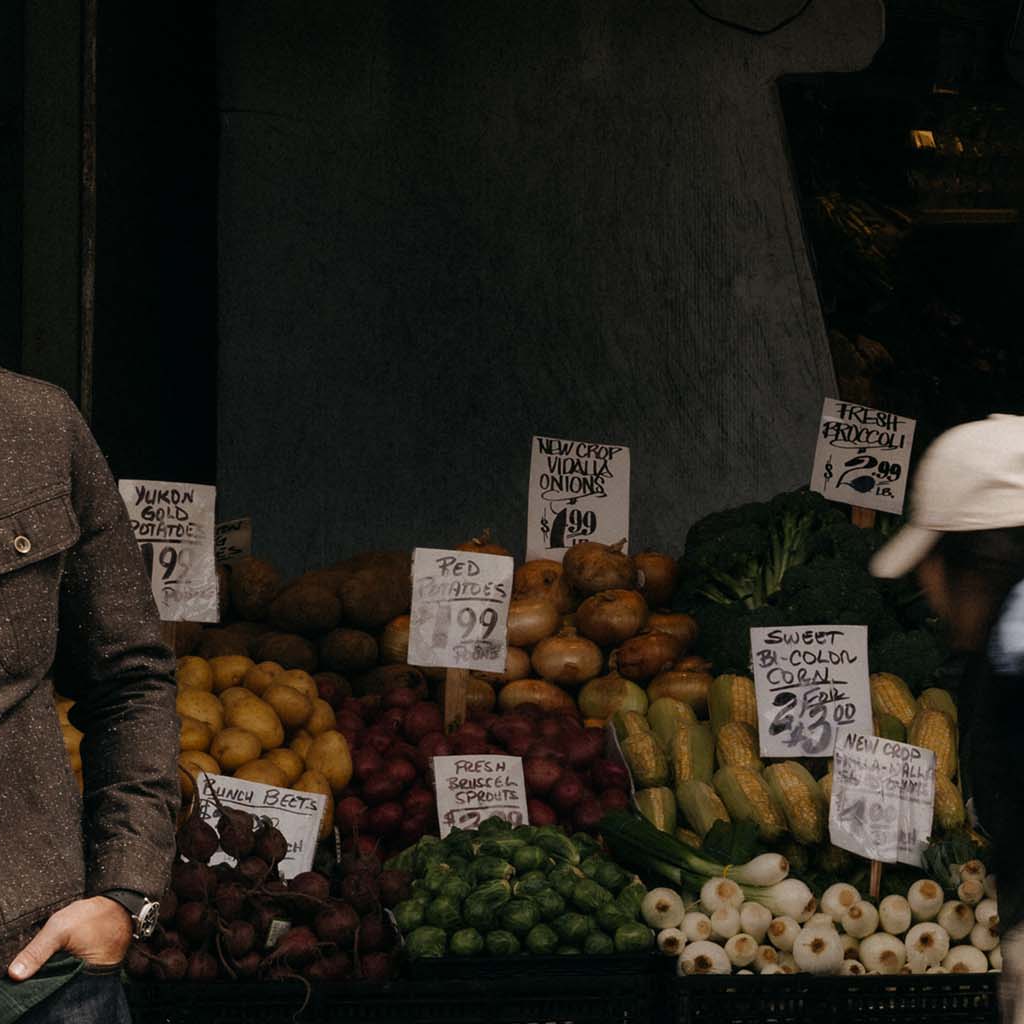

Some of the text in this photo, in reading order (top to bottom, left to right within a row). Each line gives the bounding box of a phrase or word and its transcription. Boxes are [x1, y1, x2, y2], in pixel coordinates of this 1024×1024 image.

[836, 402, 907, 432] FRESH
[822, 421, 906, 449] BROCCOLI
[536, 438, 623, 460] NEW CROP
[547, 456, 614, 478] VIDALIA
[135, 485, 194, 506] YUKON
[539, 473, 607, 498] ONIONS
[141, 506, 189, 521] GOLD
[436, 556, 480, 576] RED
[764, 630, 844, 645] SWEET
[844, 733, 921, 762] NEW CROP
[454, 760, 506, 774] FRESH
[447, 776, 518, 791] BRUSSEL
[202, 778, 318, 811] BUNCH BEETS
[456, 790, 519, 804] SPROUTS
